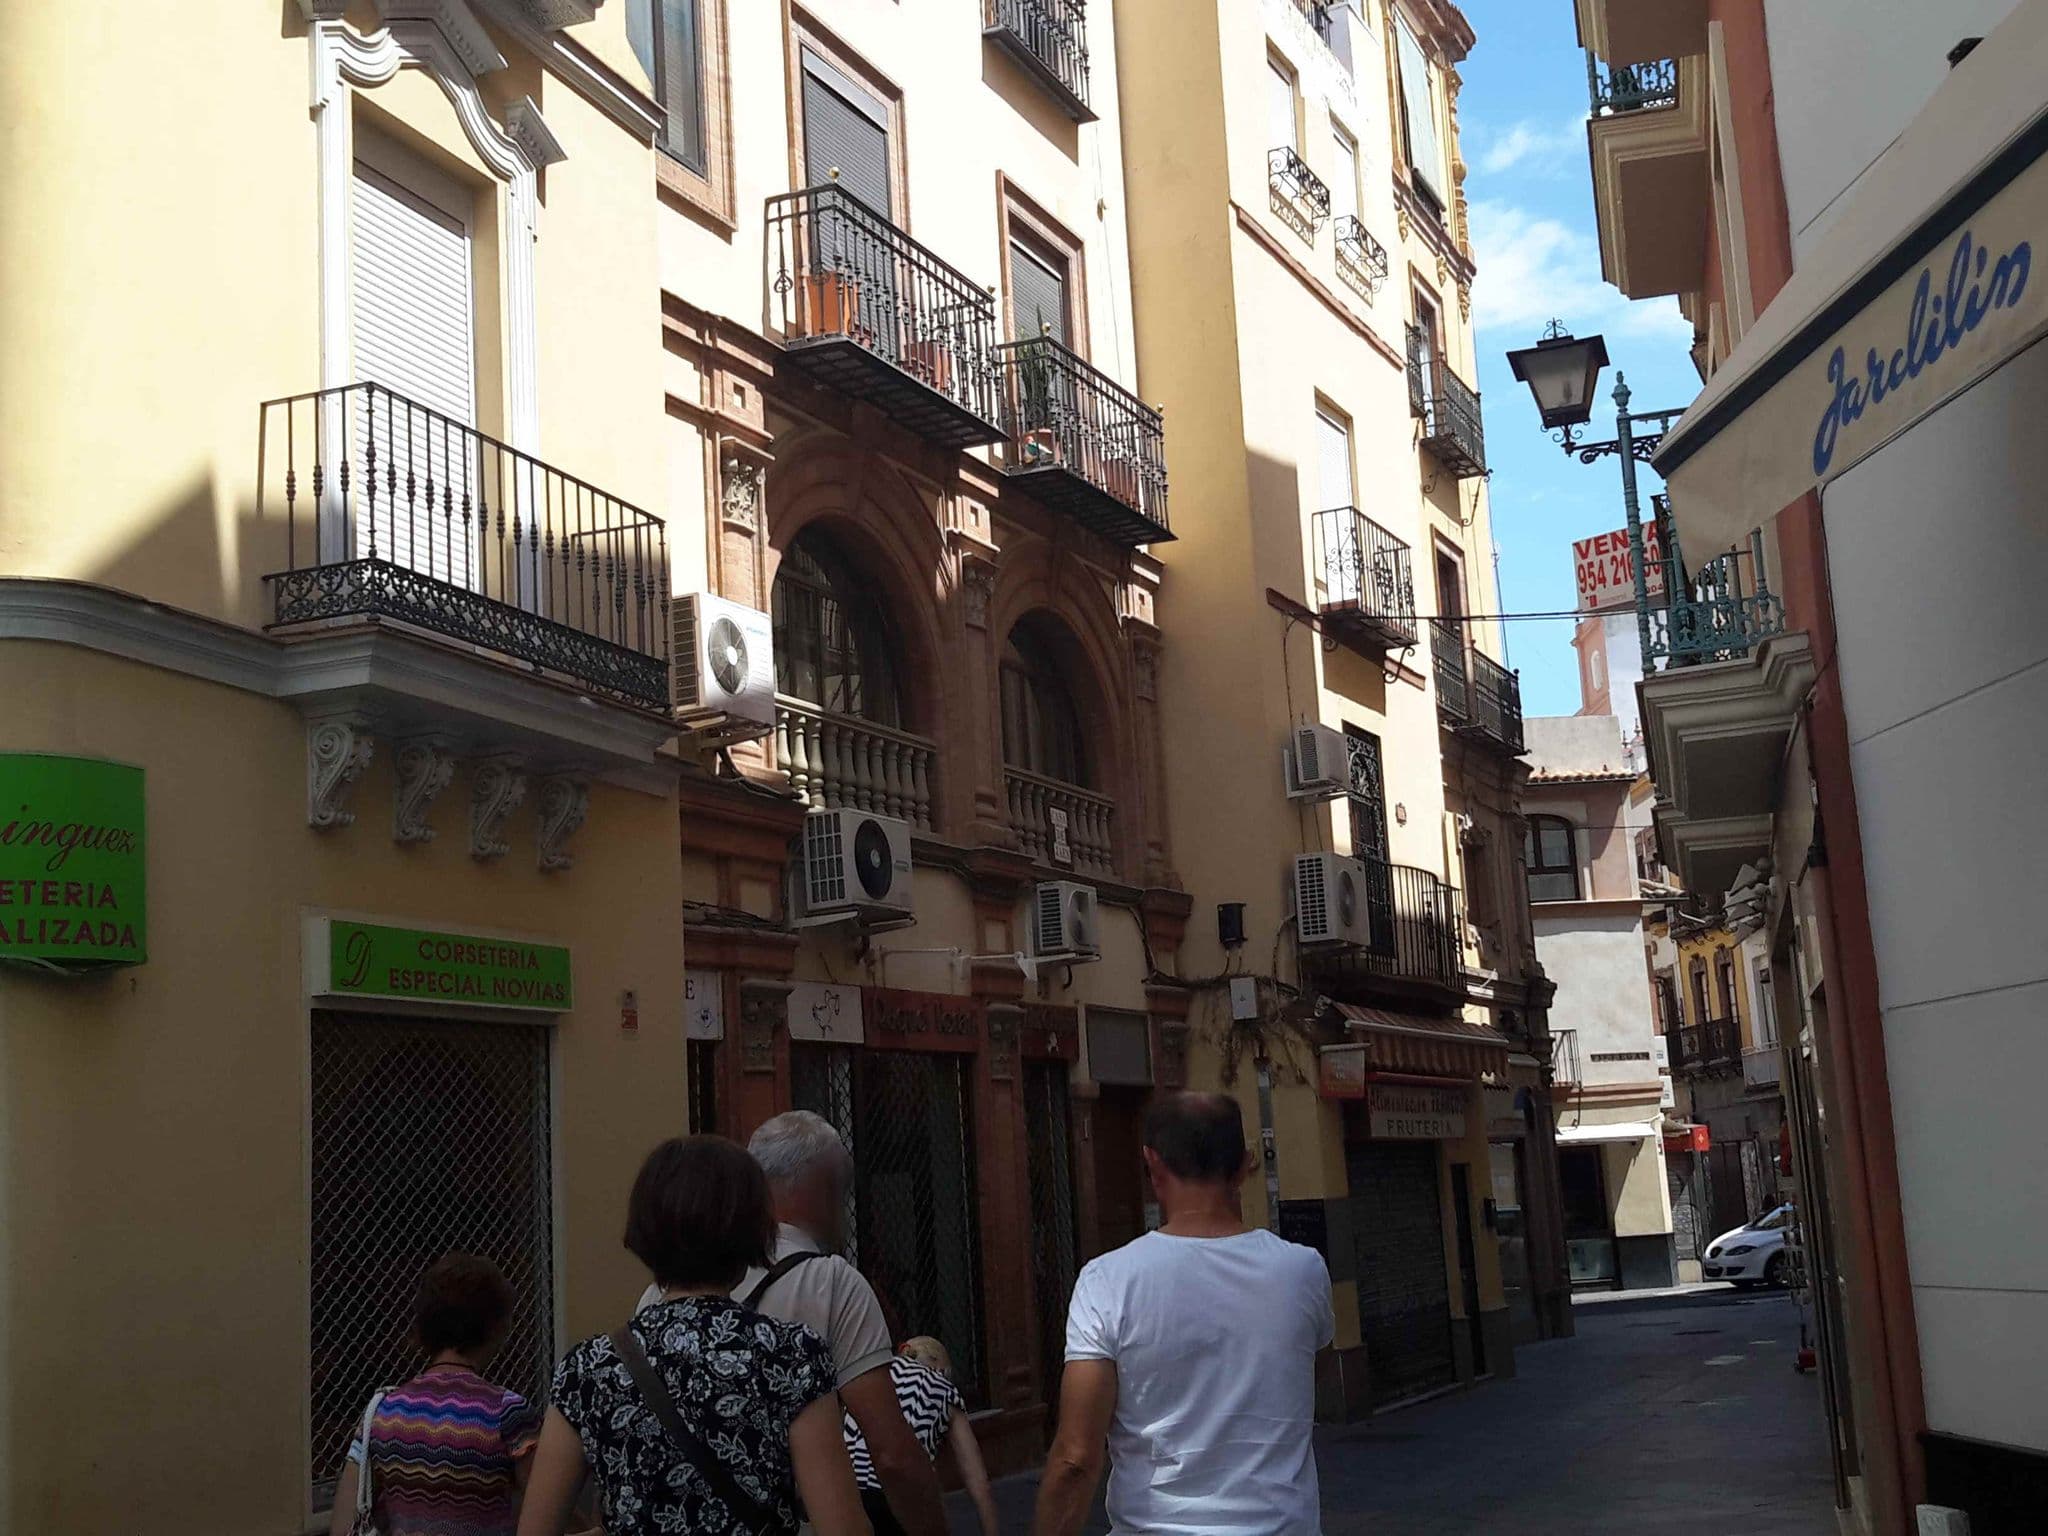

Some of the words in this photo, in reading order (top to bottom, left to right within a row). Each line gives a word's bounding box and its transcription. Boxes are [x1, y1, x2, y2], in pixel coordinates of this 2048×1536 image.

[1813, 229, 2032, 477] Jardilin
[1574, 521, 1658, 560] VENA
[1577, 558, 1607, 594] 954
[0, 879, 118, 910] ETERIA
[418, 939, 538, 968] CORSETERIA
[388, 967, 486, 996] ESPECIAL
[492, 976, 565, 1001] NOVIAS
[1386, 1119, 1456, 1136] FRUTERIA
